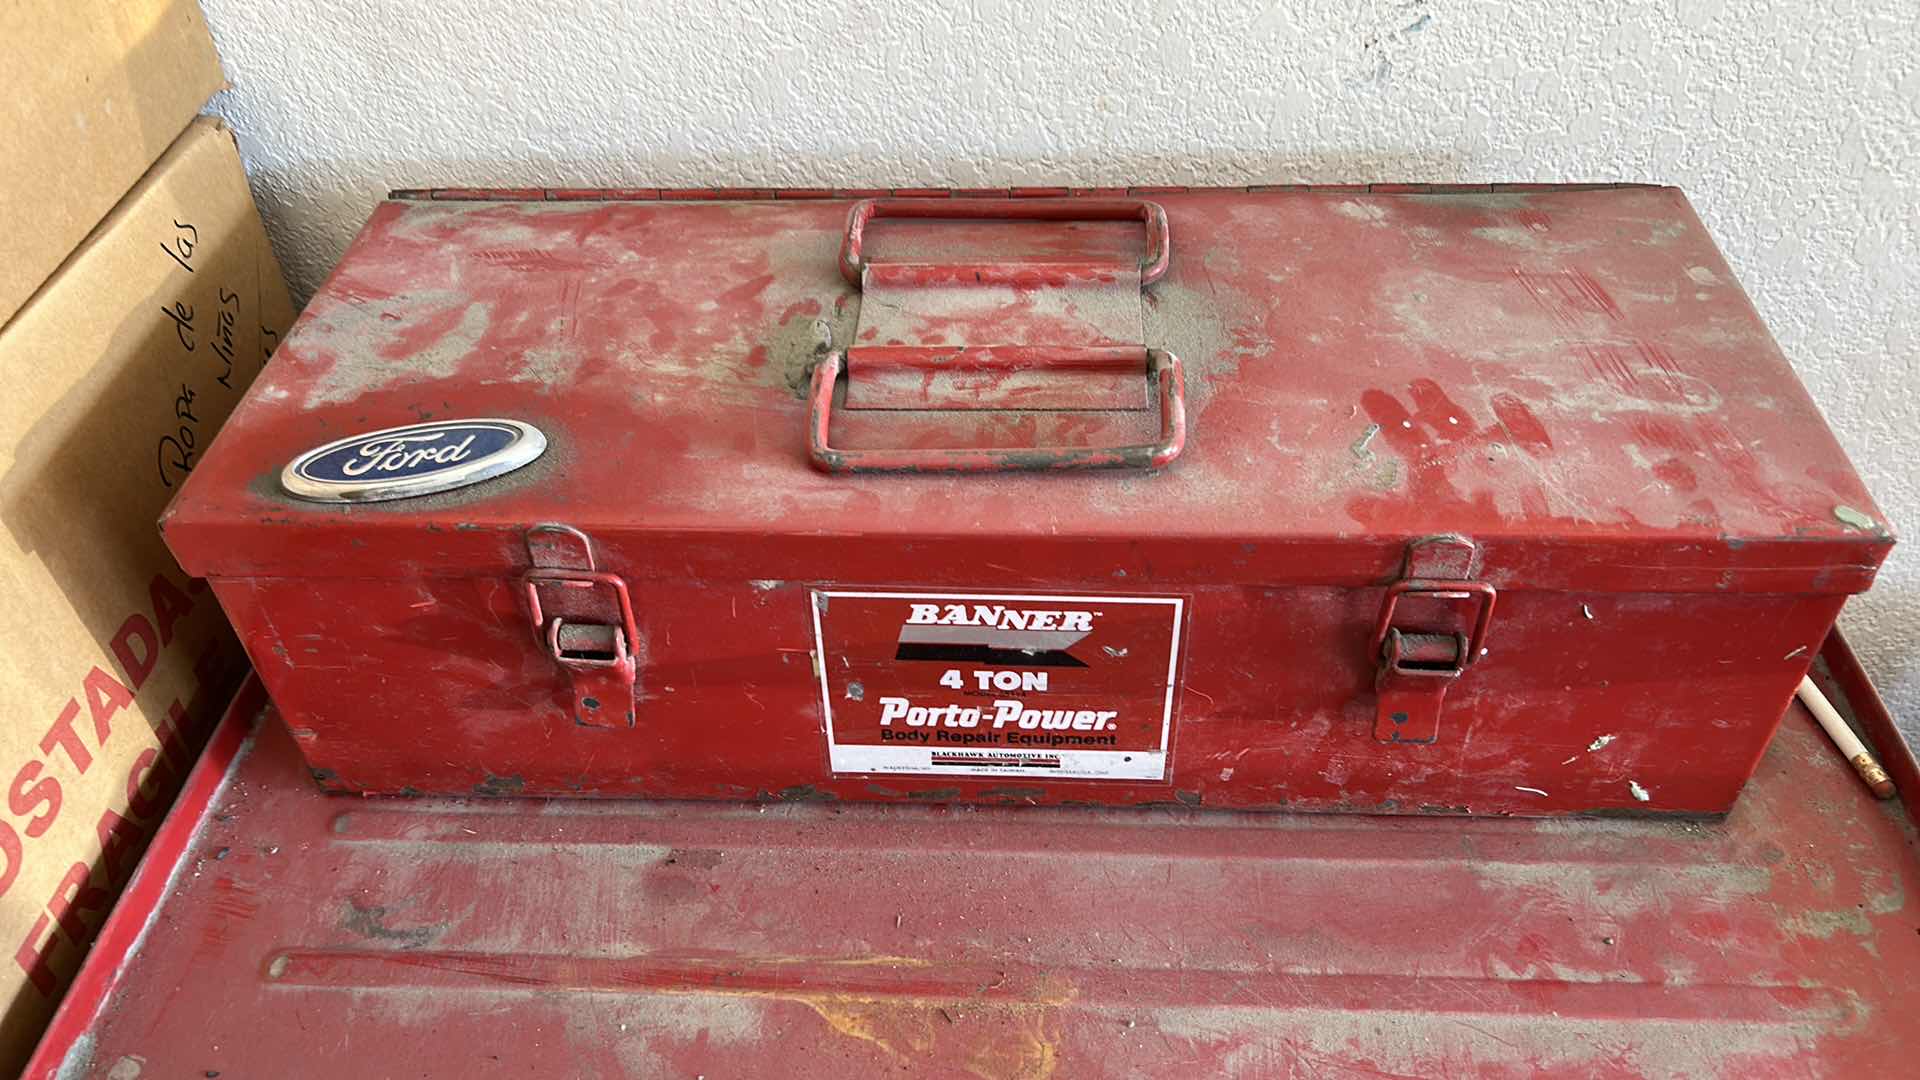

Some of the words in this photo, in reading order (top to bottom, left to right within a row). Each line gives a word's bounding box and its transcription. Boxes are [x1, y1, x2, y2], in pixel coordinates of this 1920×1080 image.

[160, 218, 199, 273] las
[161, 301, 195, 353] de
[342, 432, 476, 477] Ford
[939, 669, 965, 690] 4
[973, 670, 1049, 692] TON
[880, 728, 930, 743] Body
[936, 730, 1001, 744] Repair
[1006, 732, 1117, 746] Equipment
